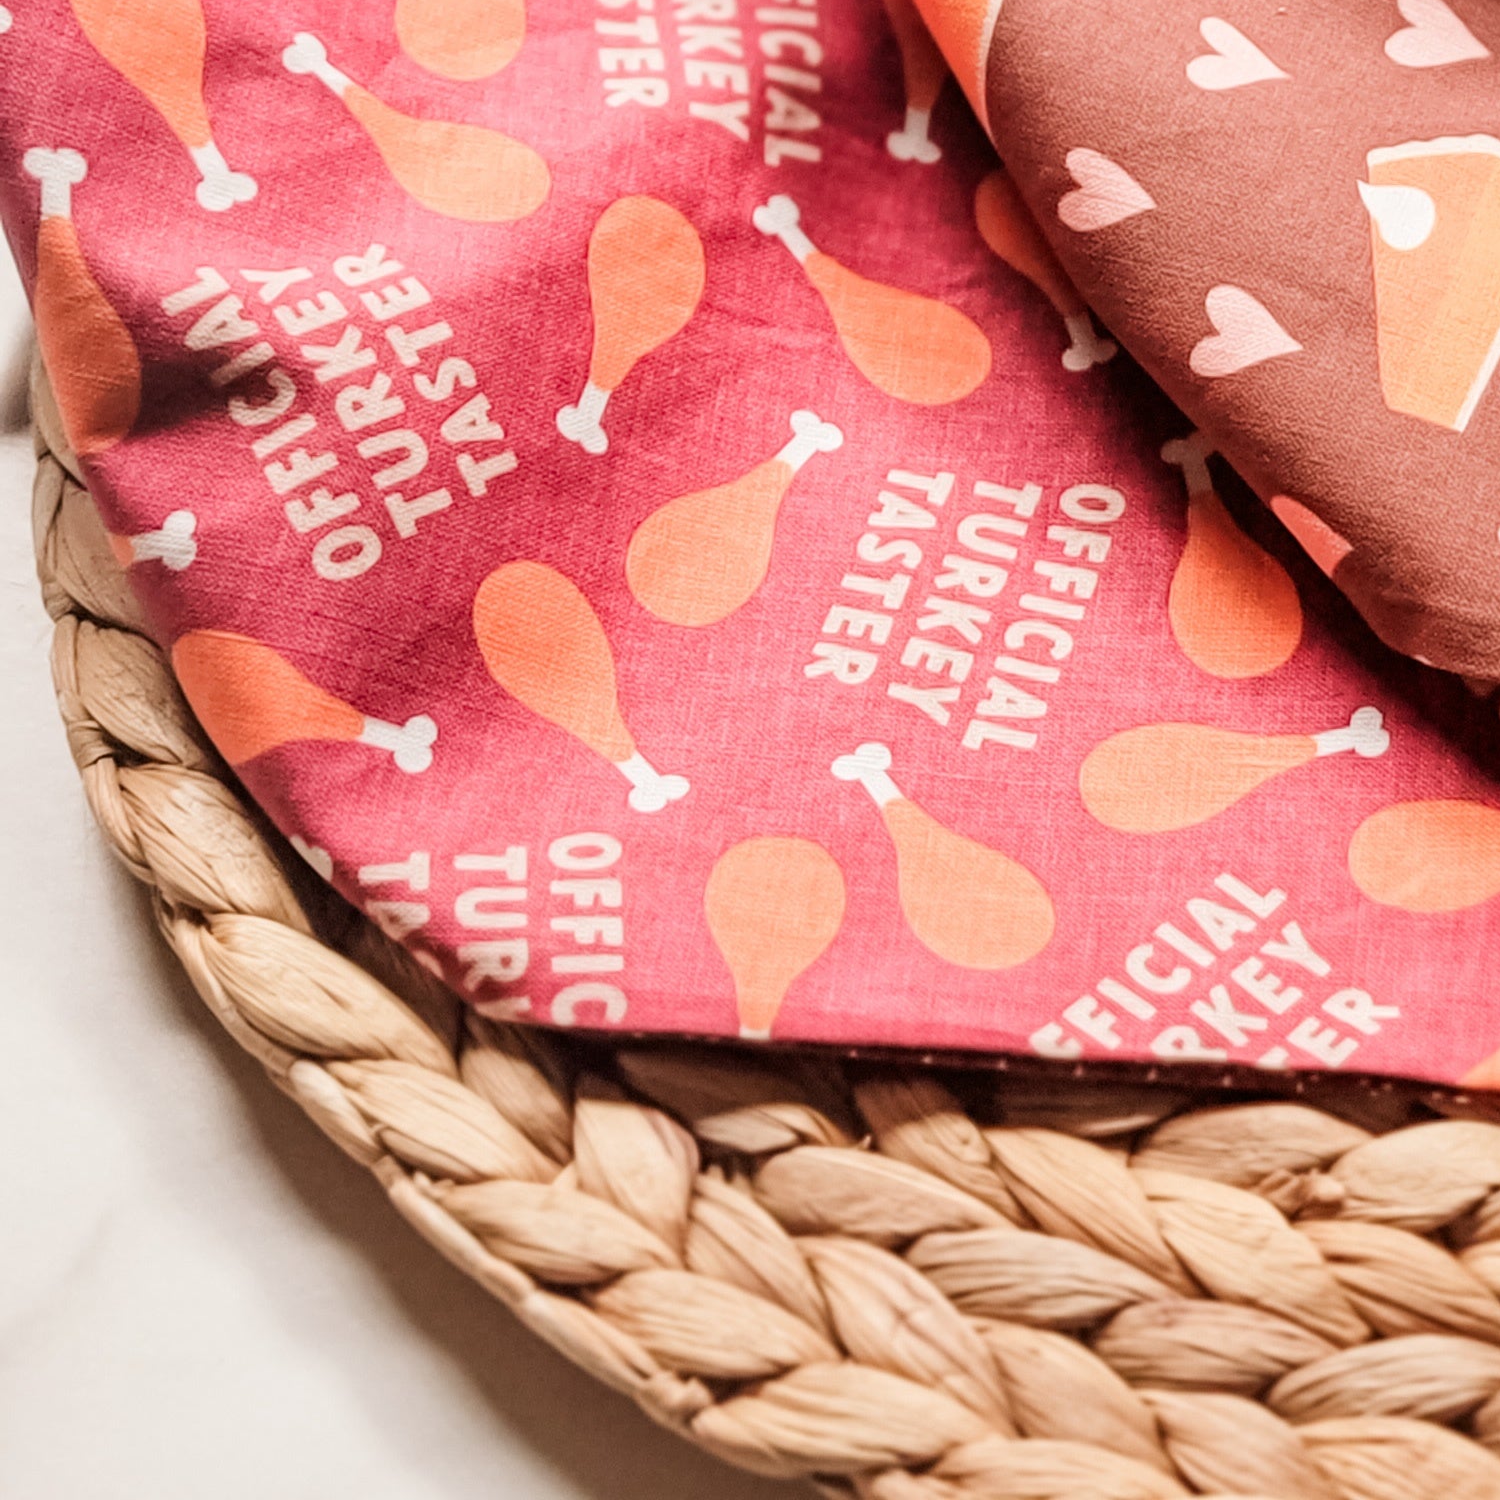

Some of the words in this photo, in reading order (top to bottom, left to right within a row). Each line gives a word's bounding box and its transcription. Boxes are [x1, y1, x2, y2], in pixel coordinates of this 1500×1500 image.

[161, 267, 383, 581] OFFICIAL
[240, 267, 453, 539] TURKEY
[332, 244, 518, 496] TASTER
[804, 469, 955, 685] TASTER
[887, 481, 1044, 727] TURKEY
[961, 483, 1127, 751] OFFICIAL
[358, 851, 445, 980] TA
[1255, 987, 1400, 1070] ER
